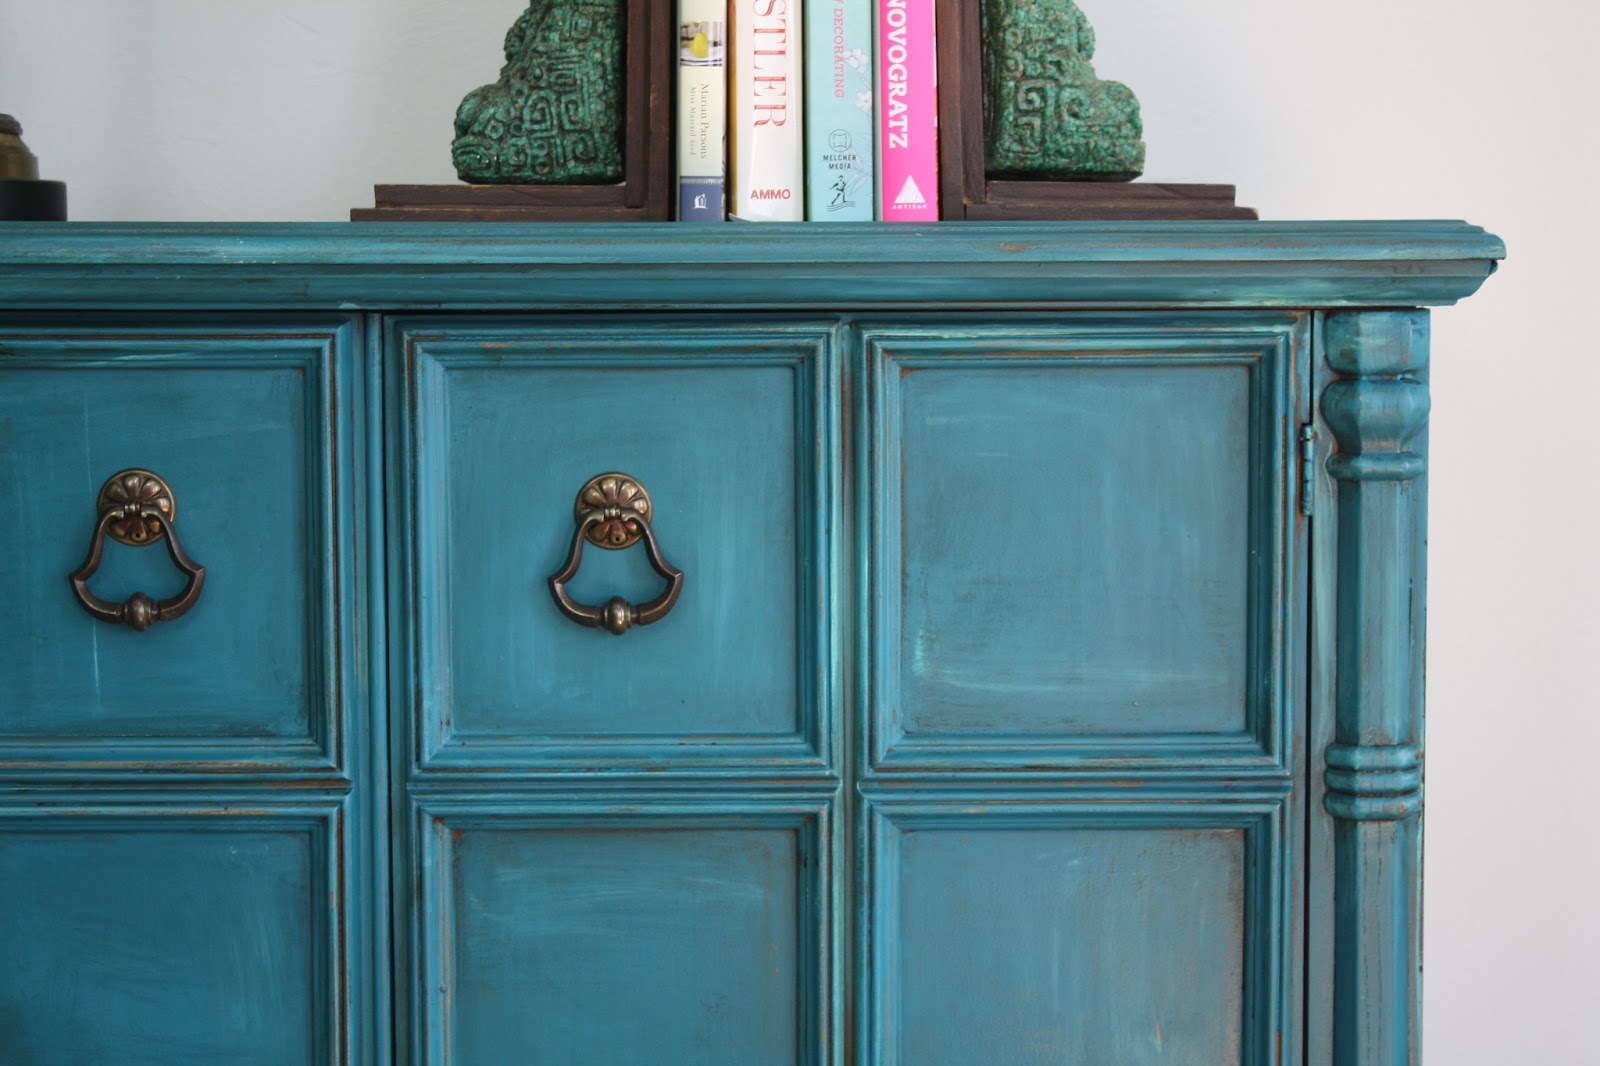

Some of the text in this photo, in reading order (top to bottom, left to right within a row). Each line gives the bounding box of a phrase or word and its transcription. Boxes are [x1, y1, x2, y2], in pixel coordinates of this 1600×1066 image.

[753, 0, 787, 127] STLER
[833, 8, 845, 98] DECORATING
[700, 83, 710, 160] Marian Parsons
[823, 154, 857, 162] MELCHER
[750, 188, 791, 200] AMMO
